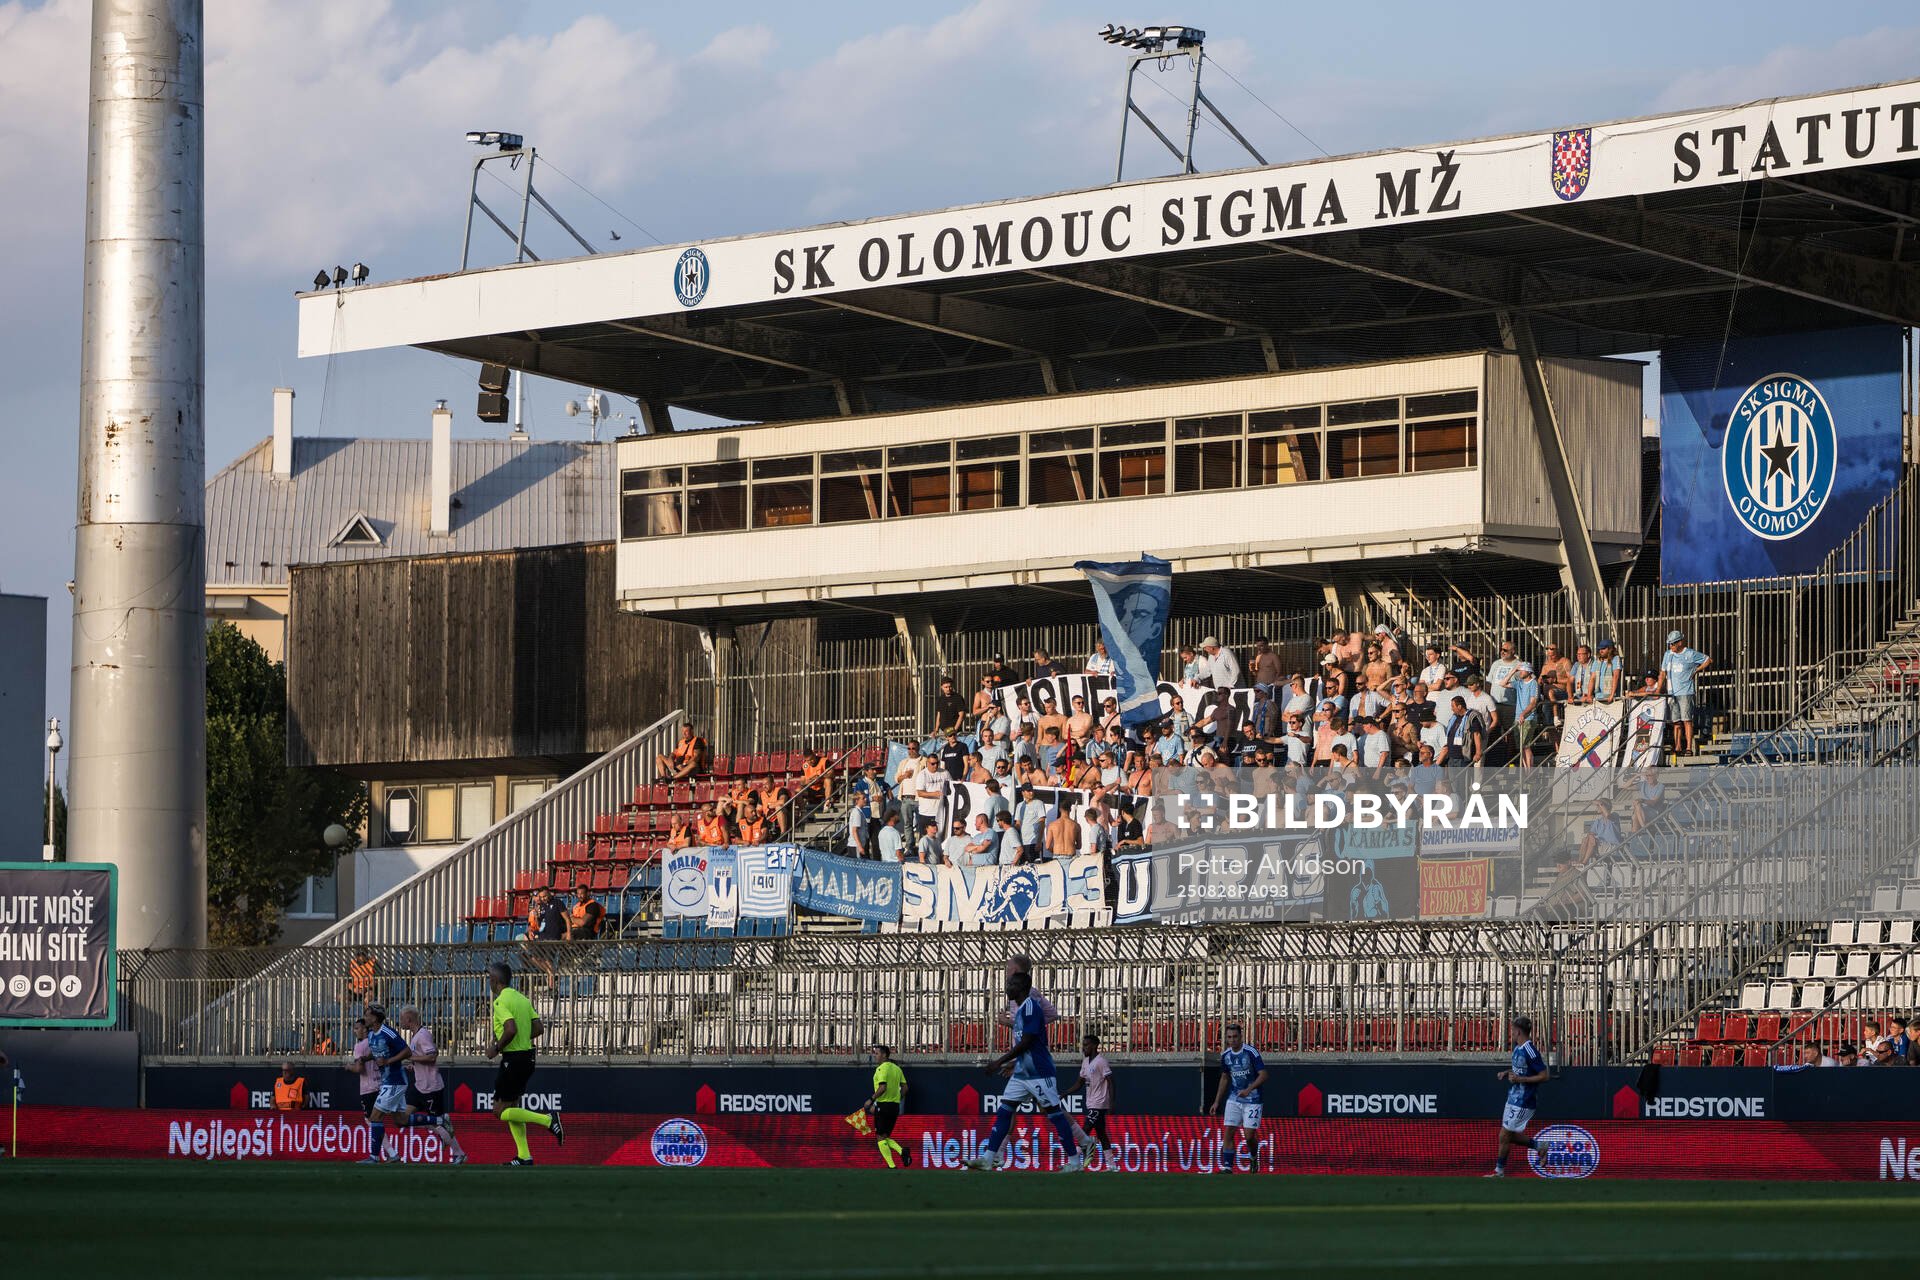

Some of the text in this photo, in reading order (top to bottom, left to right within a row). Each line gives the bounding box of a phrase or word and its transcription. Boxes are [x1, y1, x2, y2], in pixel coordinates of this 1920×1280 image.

[774, 101, 1920, 295] SK OLOMOUC SIGMA MŽ STATUT
[678, 289, 706, 306] OLOMOUC
[1740, 381, 1816, 422] SK SIGMA
[1739, 489, 1821, 532] OLOMOUC
[1422, 863, 1484, 888] SKÅNELAGET
[44, 889, 94, 924] NAŠE
[1211, 902, 1275, 920] MALMÖ
[1429, 889, 1469, 914] EUROPA
[48, 926, 88, 962] SÍTĚ
[476, 1092, 562, 1111] RETONE
[719, 1094, 812, 1112] REDSTONE
[1248, 1109, 1259, 1119] 22
[1327, 1094, 1438, 1113] REDSTONE
[1645, 1096, 1765, 1117] REDSTONE
[168, 1118, 274, 1160] Nejlepší
